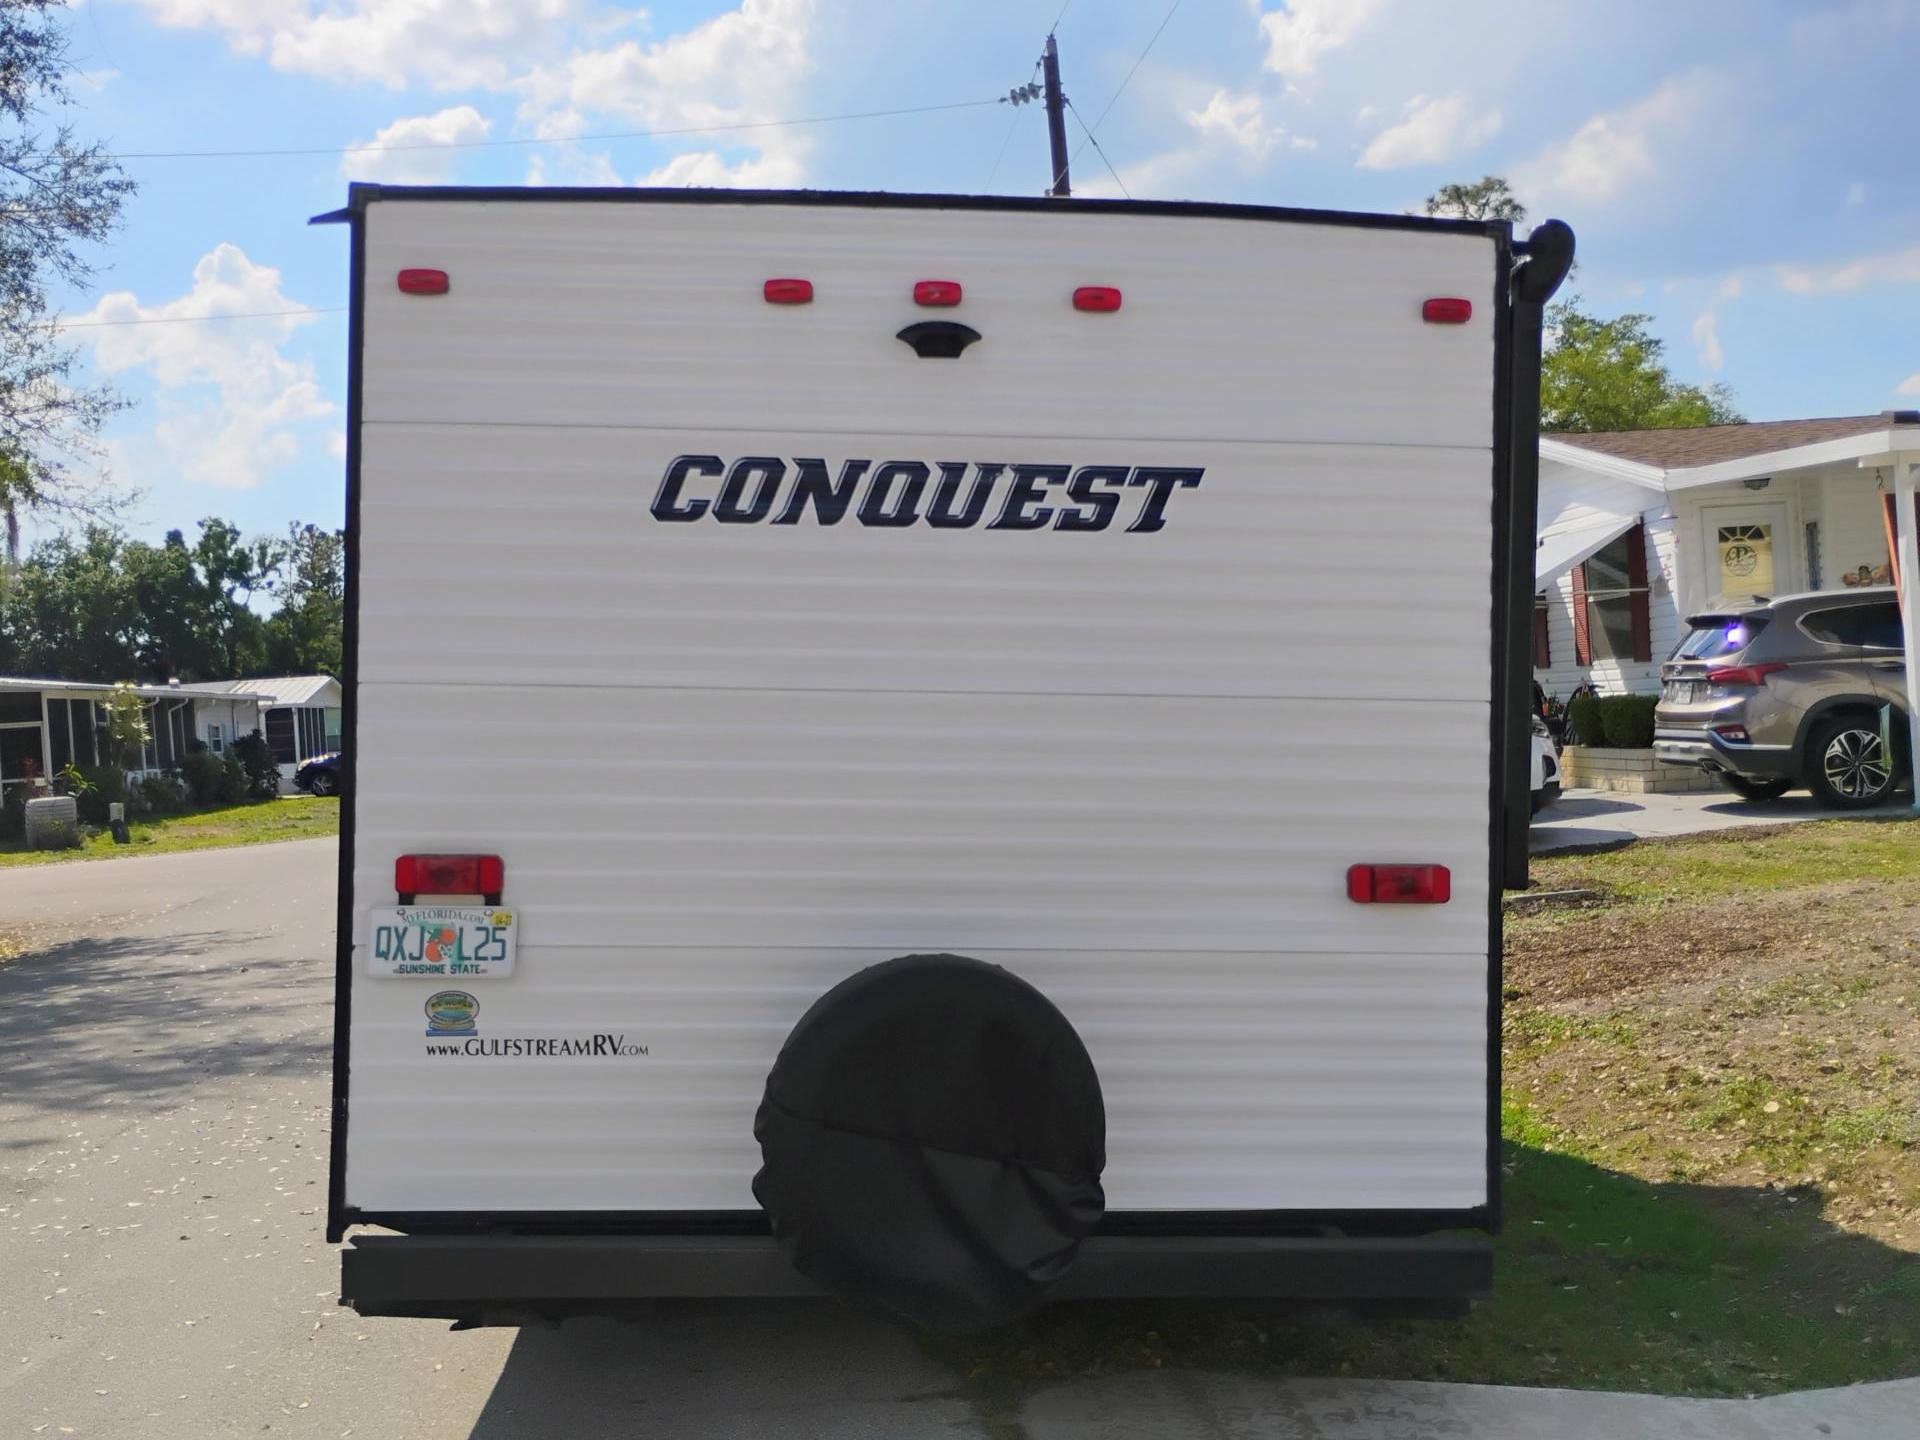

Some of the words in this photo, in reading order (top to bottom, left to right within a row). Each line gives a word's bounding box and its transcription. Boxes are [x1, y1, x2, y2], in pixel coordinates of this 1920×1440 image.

[650, 455, 1205, 532] CONQUEST
[375, 926, 426, 961] QXJ
[457, 926, 507, 961] L25
[399, 963, 446, 975] SUNSHINE
[450, 963, 481, 974] STATE
